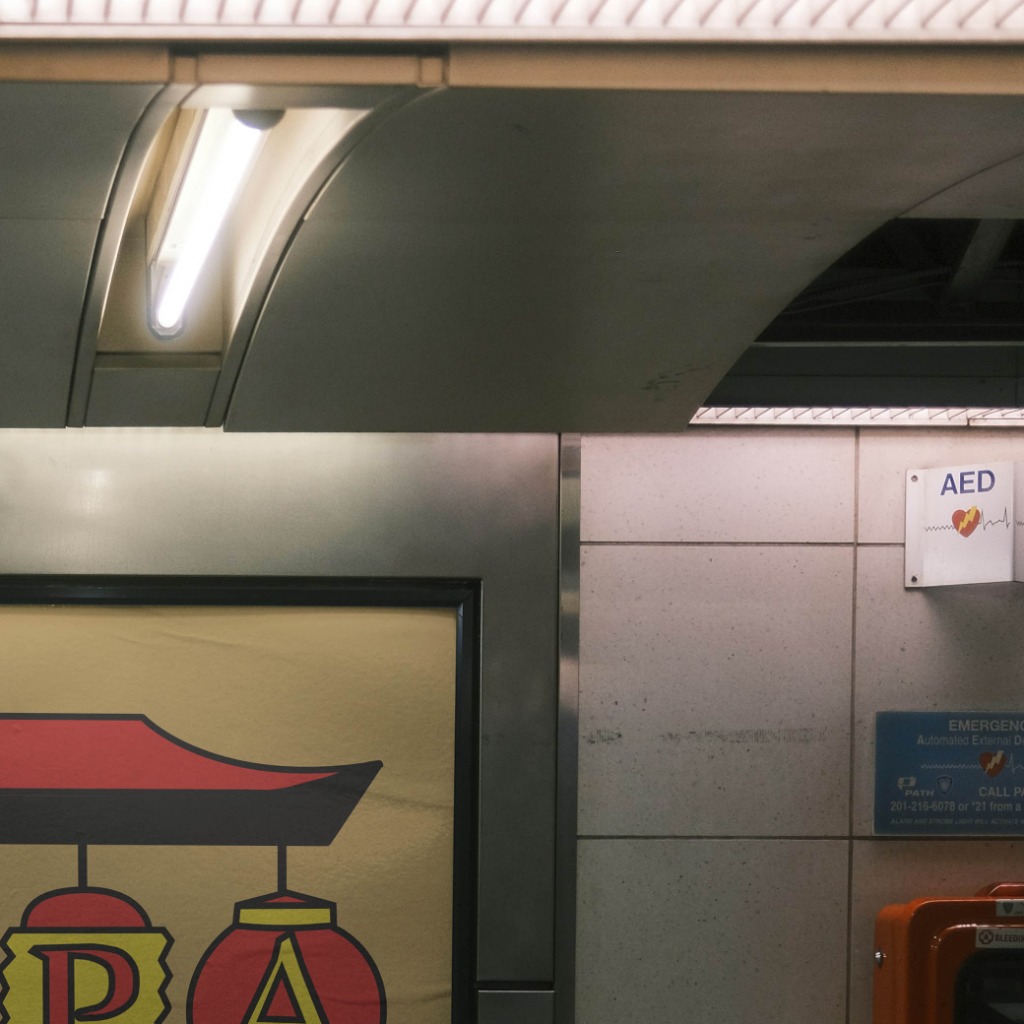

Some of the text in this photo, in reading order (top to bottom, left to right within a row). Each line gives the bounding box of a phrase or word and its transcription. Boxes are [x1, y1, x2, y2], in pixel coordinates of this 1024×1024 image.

[940, 470, 995, 495] AED
[917, 735, 969, 745] Automated
[972, 735, 1011, 745] External
[979, 786, 1011, 797] CALL
[958, 803, 969, 812] or
[990, 801, 1013, 812] from
[1015, 803, 1021, 812] a
